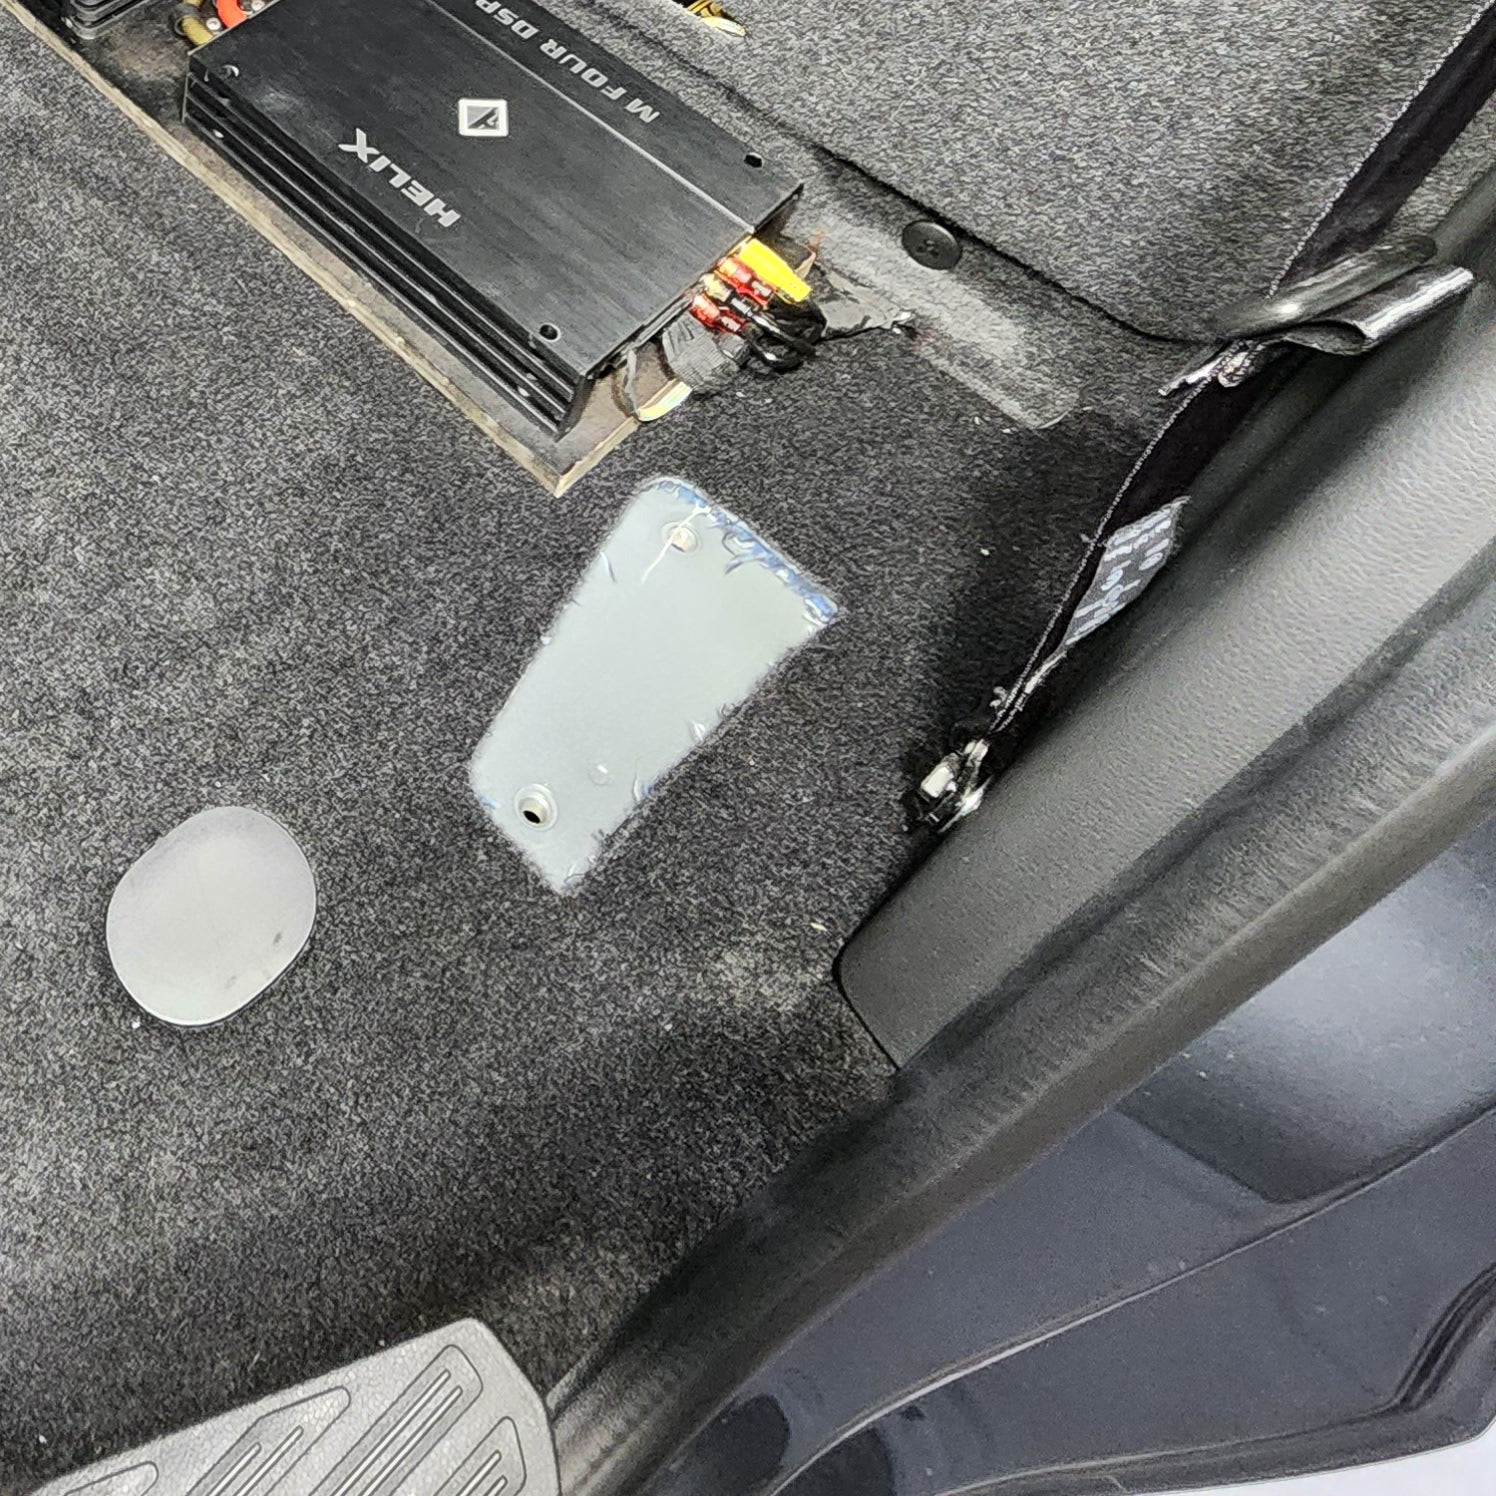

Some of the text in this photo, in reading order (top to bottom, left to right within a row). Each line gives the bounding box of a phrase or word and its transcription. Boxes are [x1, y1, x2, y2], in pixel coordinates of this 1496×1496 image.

[539, 39, 627, 100] FOUR
[624, 98, 660, 123] M
[338, 127, 462, 227] HELIX
